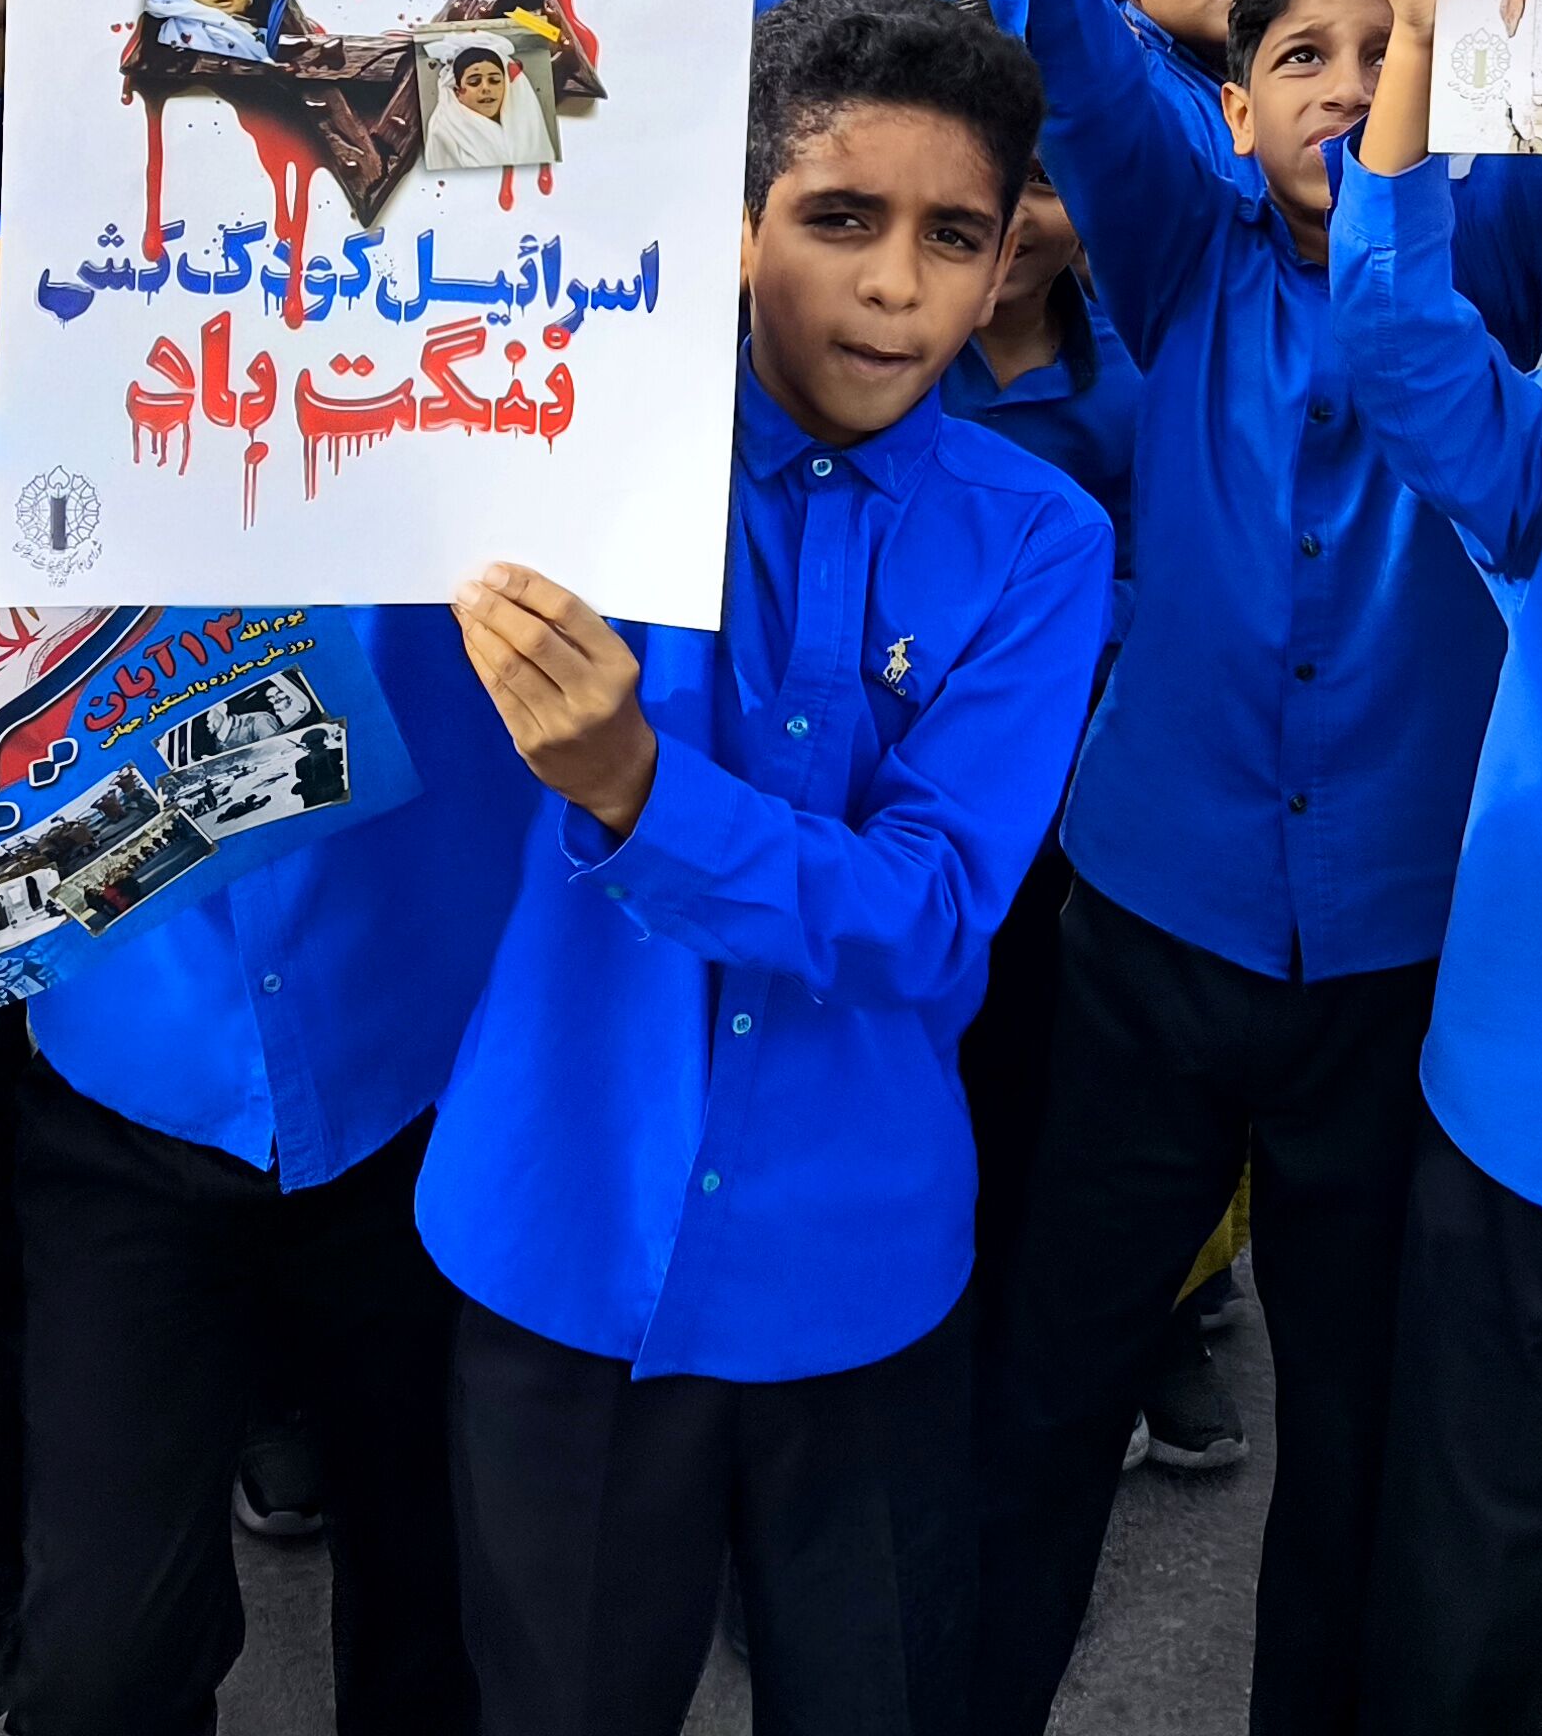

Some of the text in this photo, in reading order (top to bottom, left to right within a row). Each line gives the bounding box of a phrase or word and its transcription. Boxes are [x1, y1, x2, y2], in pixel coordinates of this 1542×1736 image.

[375, 227, 660, 331] اسرائیل
[287, 638, 316, 655] روز
[84, 607, 307, 732] یوم الله ۱۳ آبان
[209, 659, 255, 686] مبارزه
[147, 684, 196, 723] استکبار
[100, 716, 144, 750] جهانی
